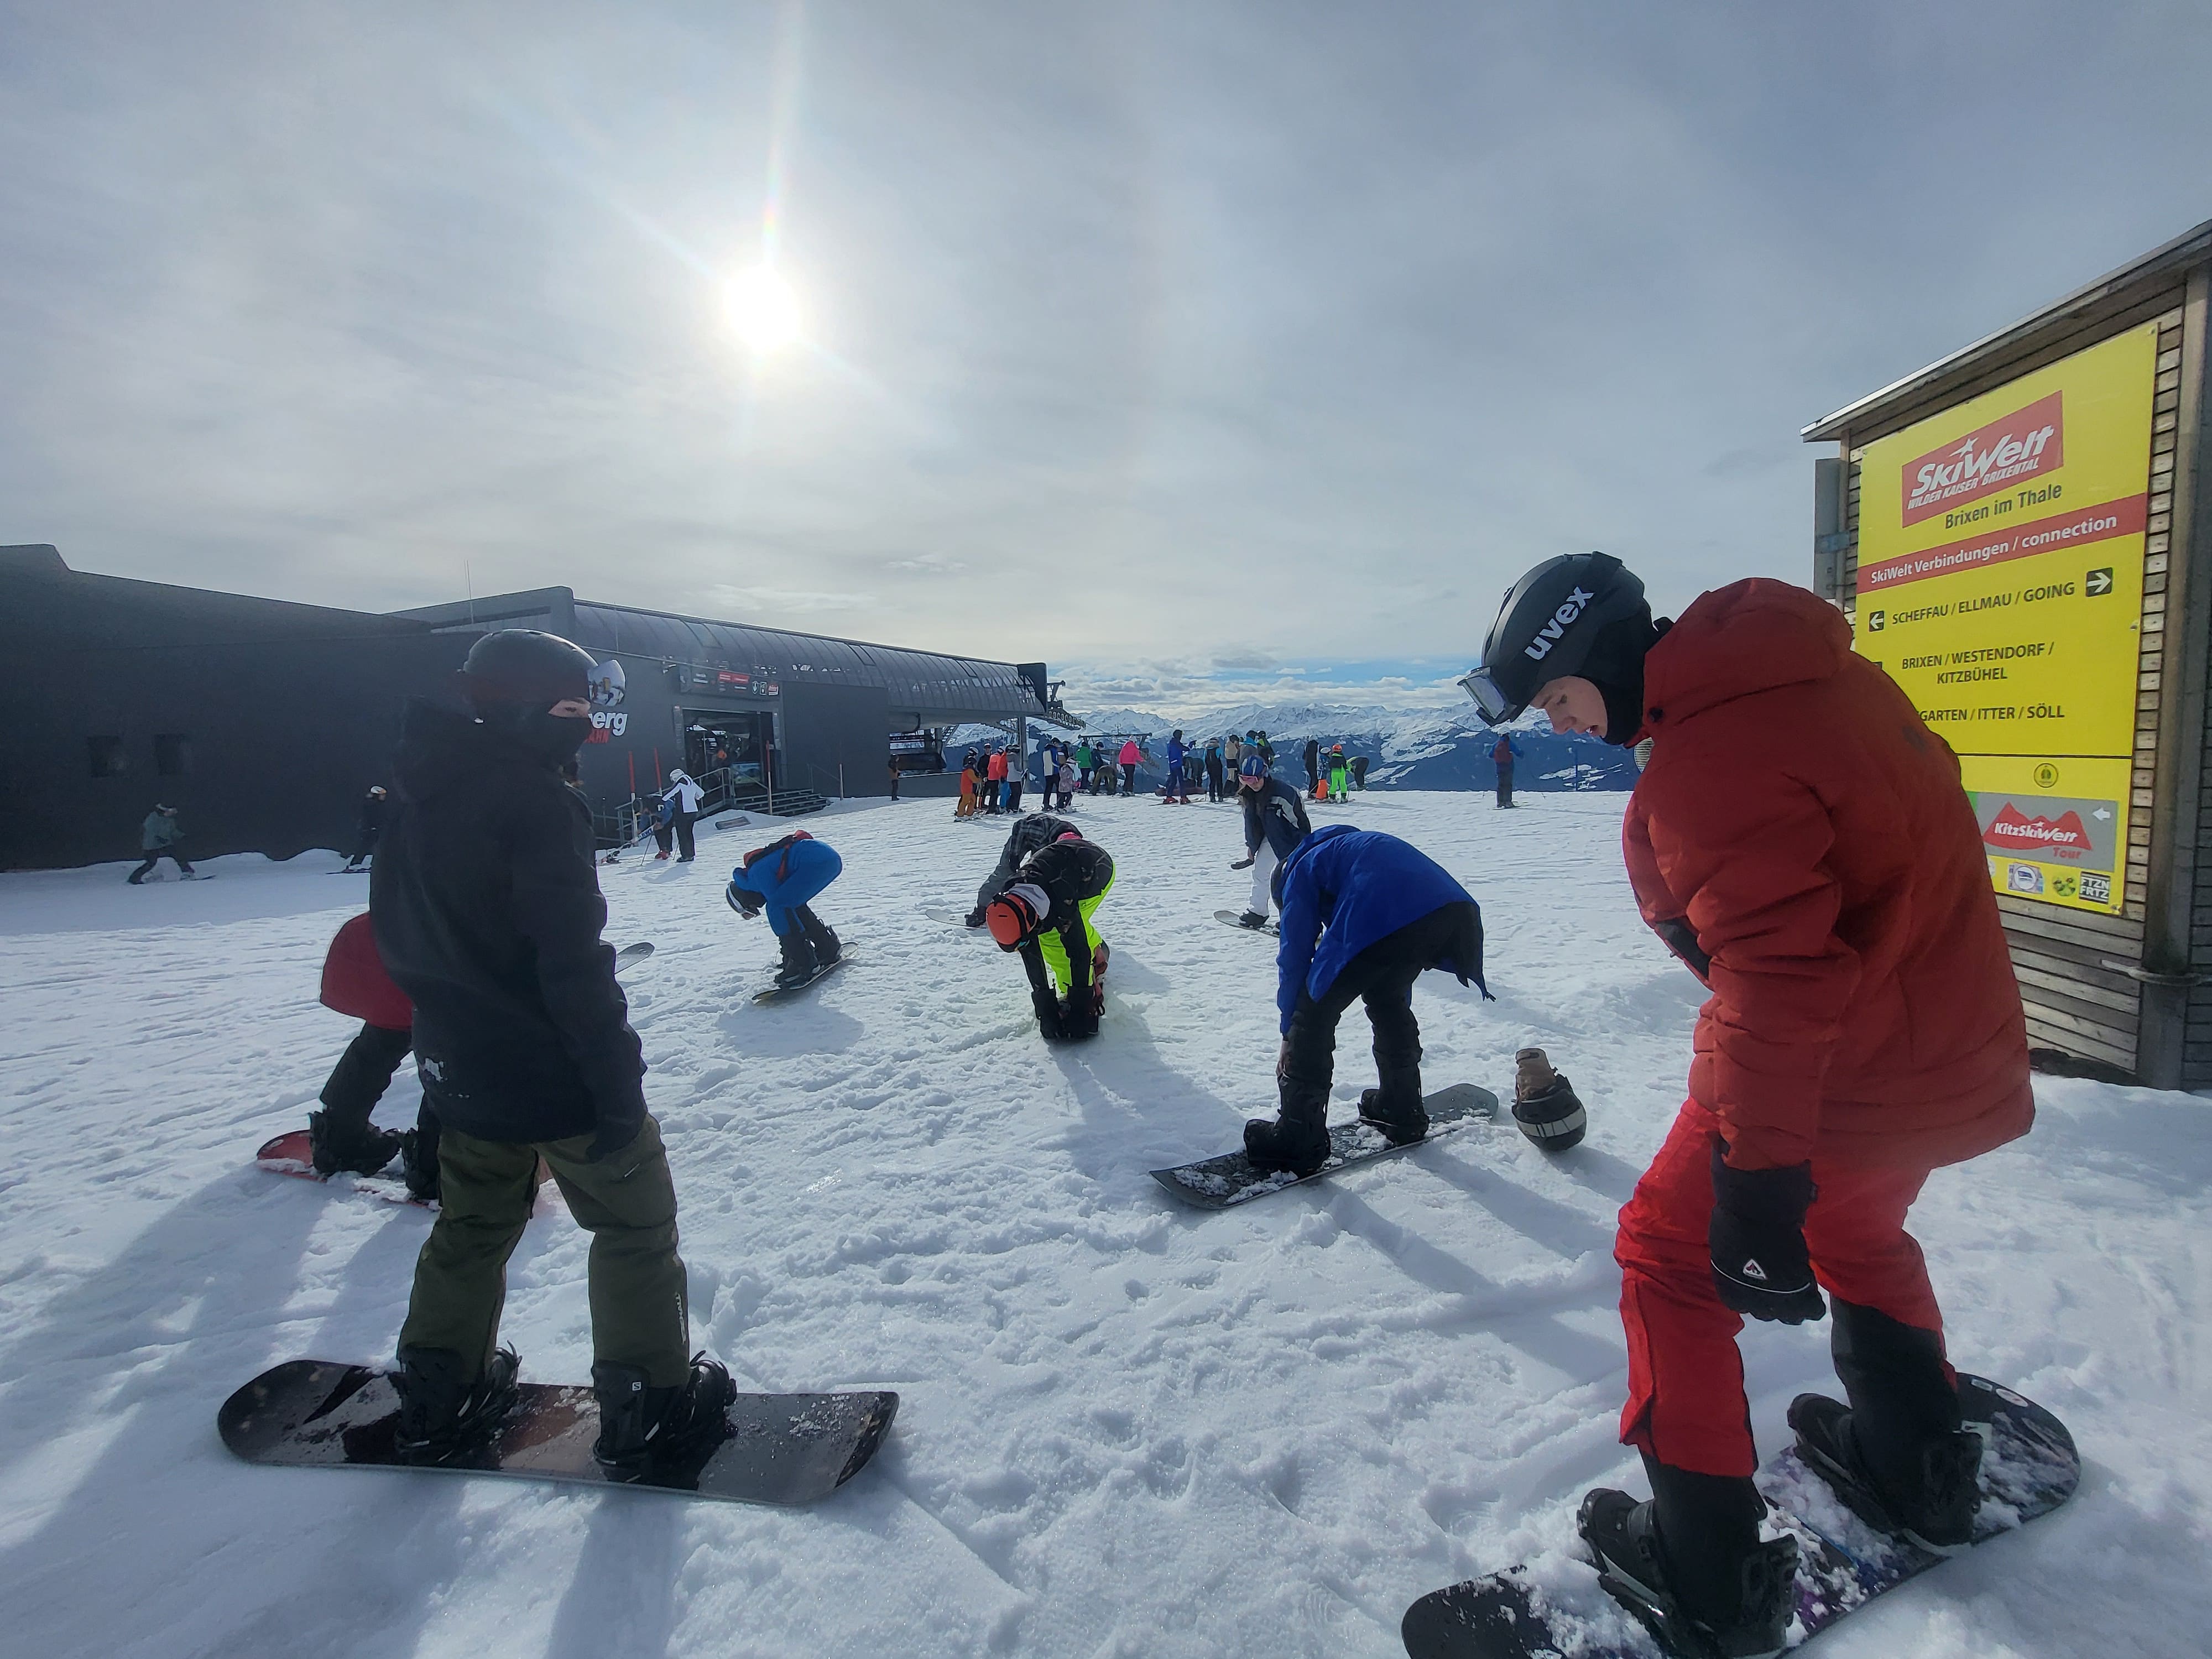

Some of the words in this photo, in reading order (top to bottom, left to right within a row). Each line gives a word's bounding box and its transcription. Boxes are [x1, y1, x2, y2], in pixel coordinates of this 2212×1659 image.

[1911, 425, 2054, 497] SkiWelt
[1908, 489, 1941, 509] WILDER
[1943, 478, 1978, 498] KAISER
[1982, 457, 2038, 486] BRIXENTAL
[1945, 507, 1989, 529] Brixen
[1994, 498, 2012, 515] im
[2017, 484, 2062, 508] Thale
[1871, 563, 1913, 583] SkiWelt
[1914, 542, 2008, 573] Verbindungen
[2022, 517, 2117, 548] connection
[1892, 604, 1949, 624] SCHEFFAU
[1959, 593, 2011, 613] ELLMAU
[2023, 582, 2075, 602] GOING
[1524, 586, 1595, 660] uvex
[1902, 655, 1942, 669] BRIXEN
[1952, 643, 2046, 664] WESTENDORF
[1937, 667, 2008, 684] KITZBÜHEL
[1918, 709, 1967, 721] GARTEN
[1978, 707, 2015, 720] ITTER
[2027, 702, 2065, 718] SÖLL
[1994, 822, 2078, 842] KitzSkiWelt
[2053, 847, 2082, 859] Tour
[2079, 885, 2109, 899] FRTZ
[2080, 877, 2110, 890] FTZN
